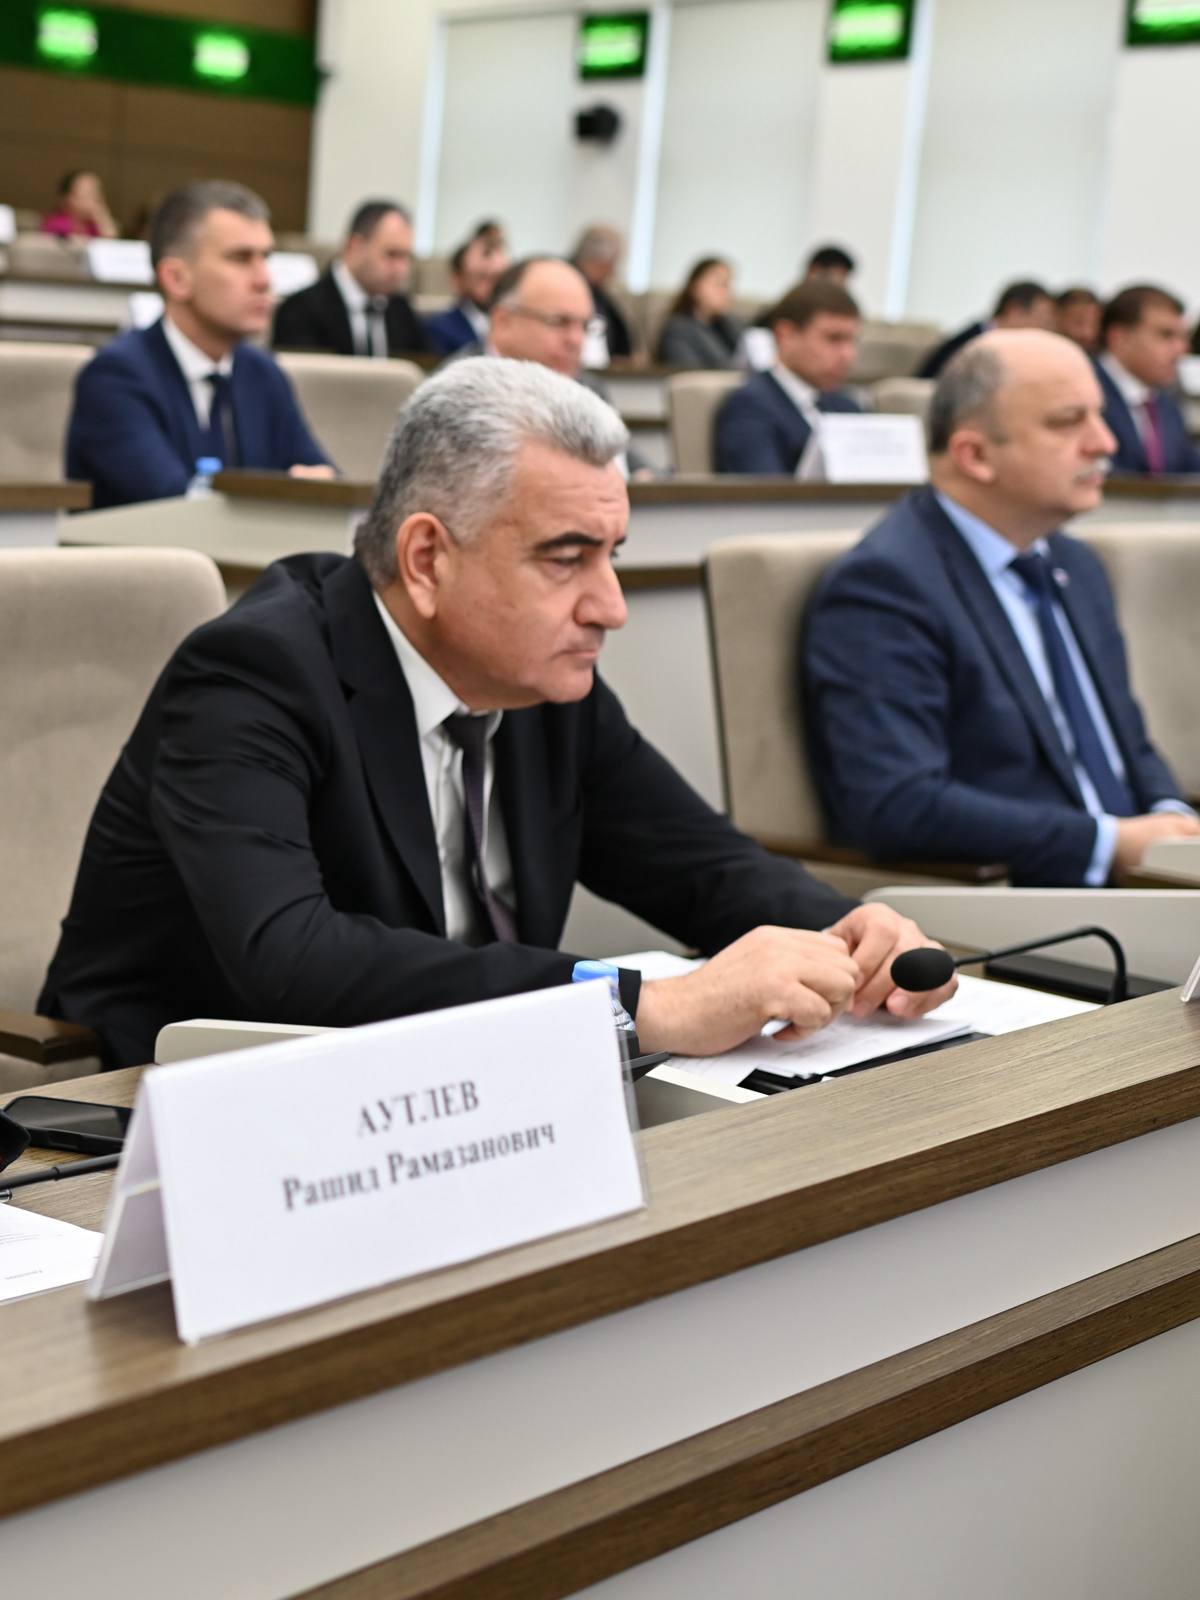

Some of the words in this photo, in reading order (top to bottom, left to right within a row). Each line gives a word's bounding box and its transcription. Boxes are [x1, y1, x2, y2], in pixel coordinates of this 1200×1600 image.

[357, 1079, 480, 1137] АУТЛЕВ
[282, 1165, 380, 1212] Рашид
[387, 1123, 556, 1185] Рамазанович
